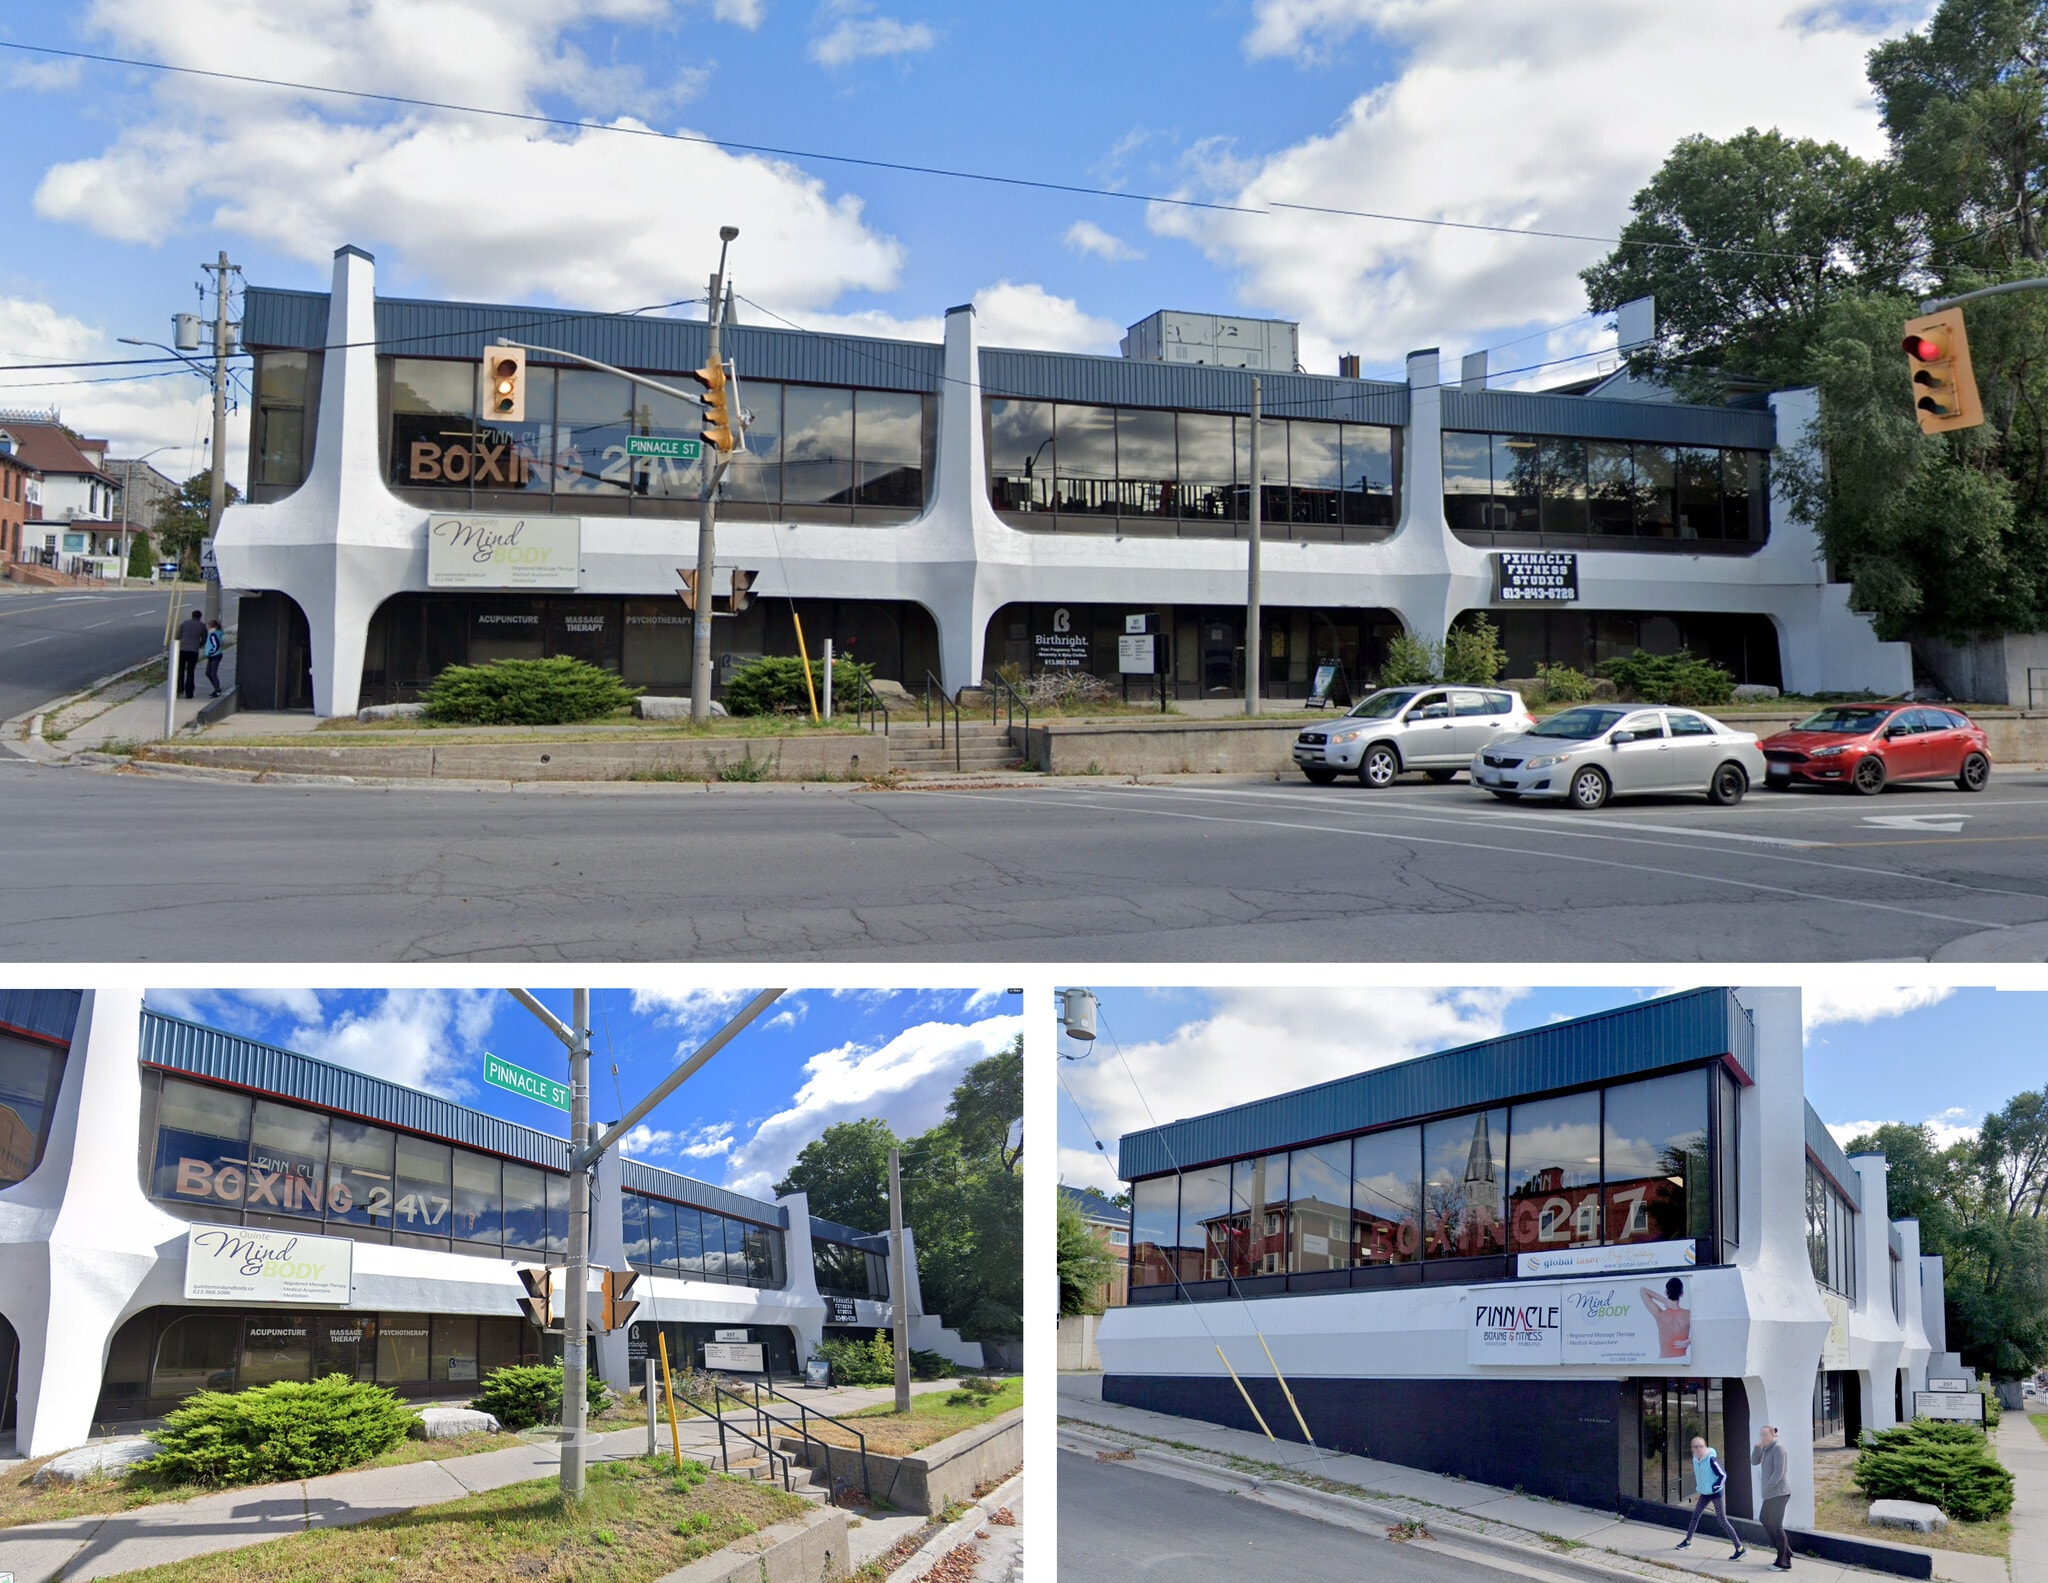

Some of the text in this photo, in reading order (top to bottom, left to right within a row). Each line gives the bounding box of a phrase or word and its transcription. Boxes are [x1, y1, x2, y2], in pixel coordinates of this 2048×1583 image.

[631, 440, 695, 454] PINNACLE ST
[409, 441, 585, 486] BOXING
[433, 520, 525, 549] Mind
[473, 545, 553, 564] & BODY
[1503, 554, 1572, 564] PINNACLE
[1507, 565, 1568, 575] FITNESS
[1513, 576, 1564, 585] STUDIO
[1503, 587, 1575, 599] 613-243-6728
[478, 615, 693, 624] ACUPUNCTURE MASSAGE PSYCHOTHERAPY
[567, 624, 603, 632] THERAPY
[490, 1061, 566, 1104] PINNACLE ST
[175, 1156, 353, 1213] BOXING
[1520, 1170, 1587, 1192] PINNCLE
[239, 1230, 271, 1241] Quinte
[1370, 1200, 1540, 1261] BOXING
[194, 1231, 298, 1261] Mind
[240, 1257, 325, 1280] & BODY
[1544, 1255, 1600, 1268] global laser
[1567, 1290, 1615, 1309] Mind
[1475, 1306, 1559, 1329] PINNACLE
[1587, 1305, 1630, 1318] & BODY
[1484, 1332, 1507, 1341] BOXING
[1515, 1332, 1543, 1341] FITNESS
